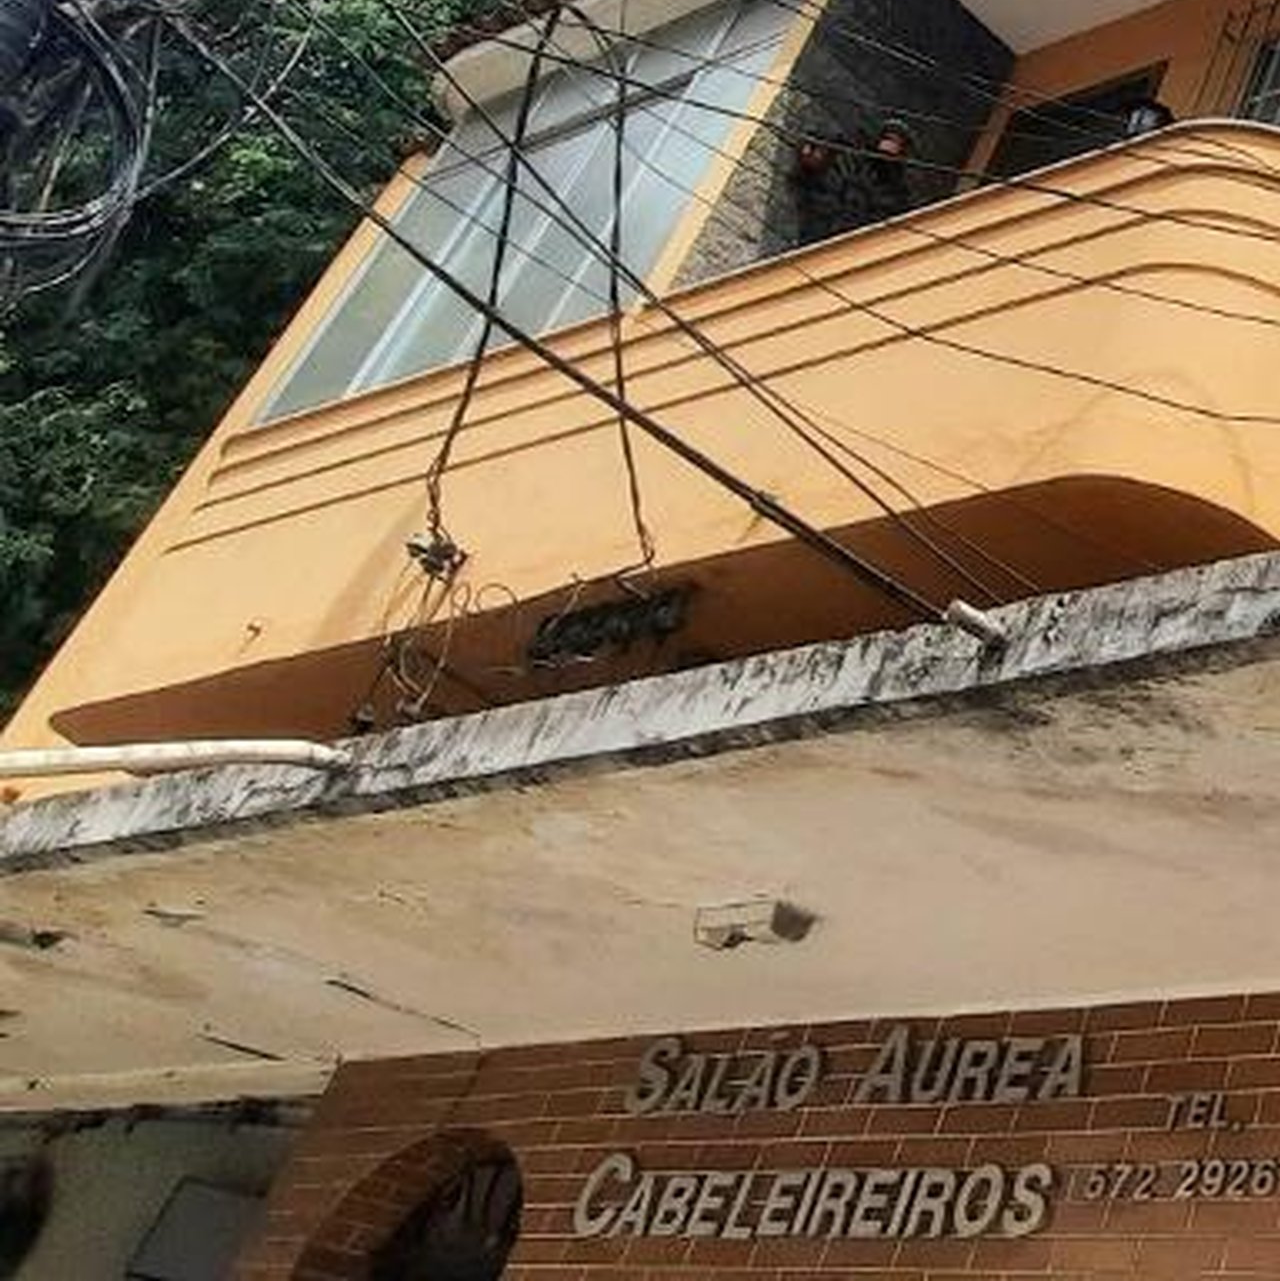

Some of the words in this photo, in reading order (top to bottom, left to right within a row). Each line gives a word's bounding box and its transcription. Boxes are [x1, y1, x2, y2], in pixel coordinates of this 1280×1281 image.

[854, 1023, 1083, 1105] AUREA
[1167, 1093, 1246, 1132] TEL.
[574, 1153, 1052, 1239] CABELEIREIROS
[1174, 1157, 1277, 1199] 2926
